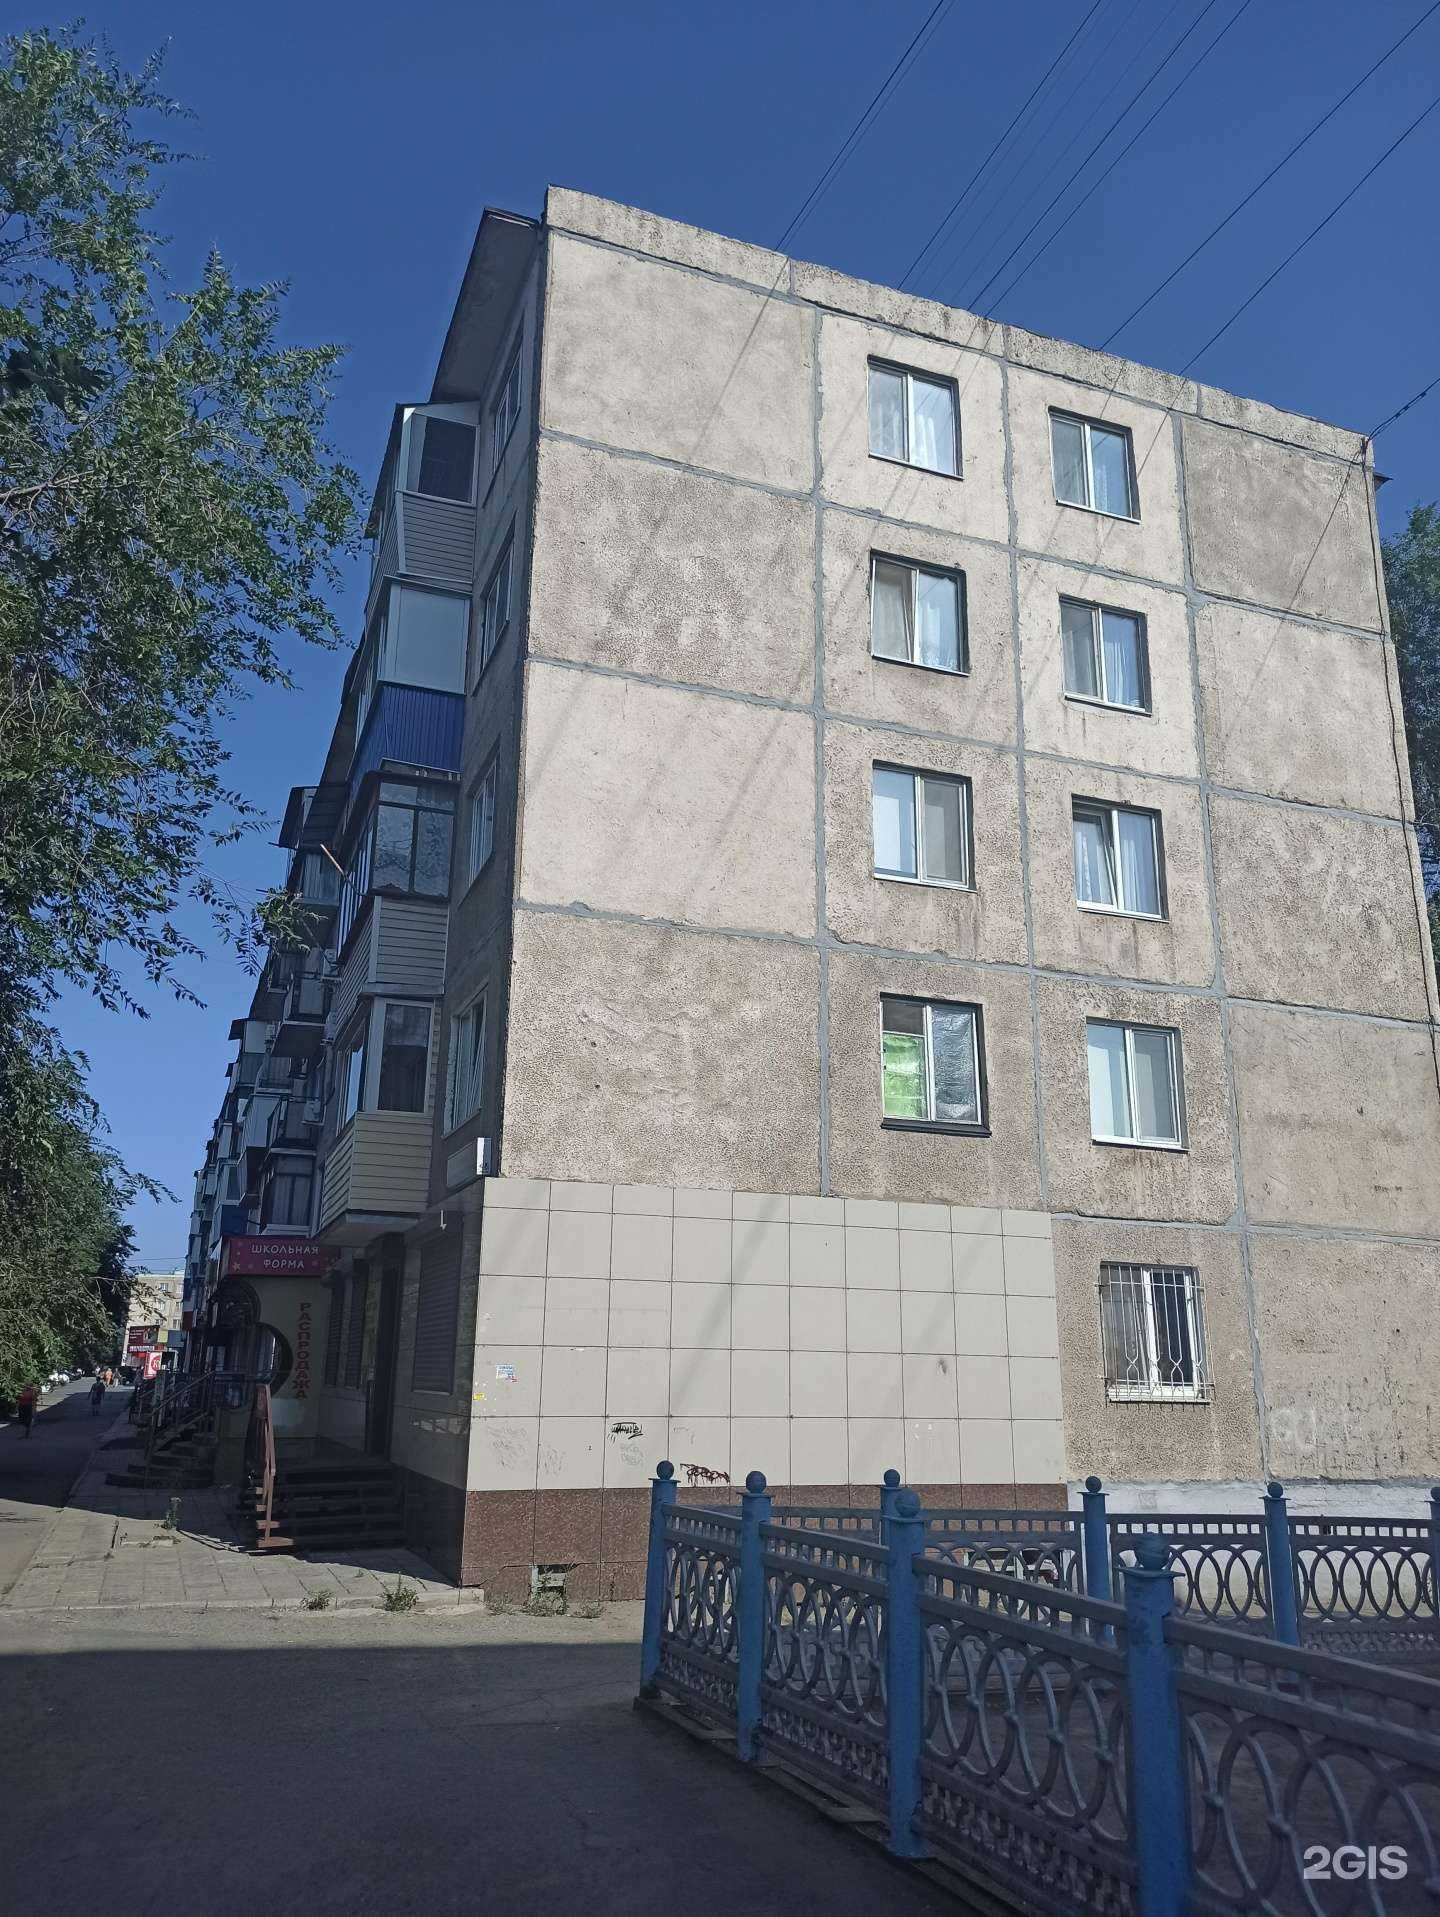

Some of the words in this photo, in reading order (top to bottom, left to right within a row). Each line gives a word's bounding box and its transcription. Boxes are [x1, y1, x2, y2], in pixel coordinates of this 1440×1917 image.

[251, 1244, 319, 1255] ШКОЛЬНАЯ
[263, 1259, 305, 1269] ФОРМА
[292, 1302, 312, 1399] РАСПРОДАЖА
